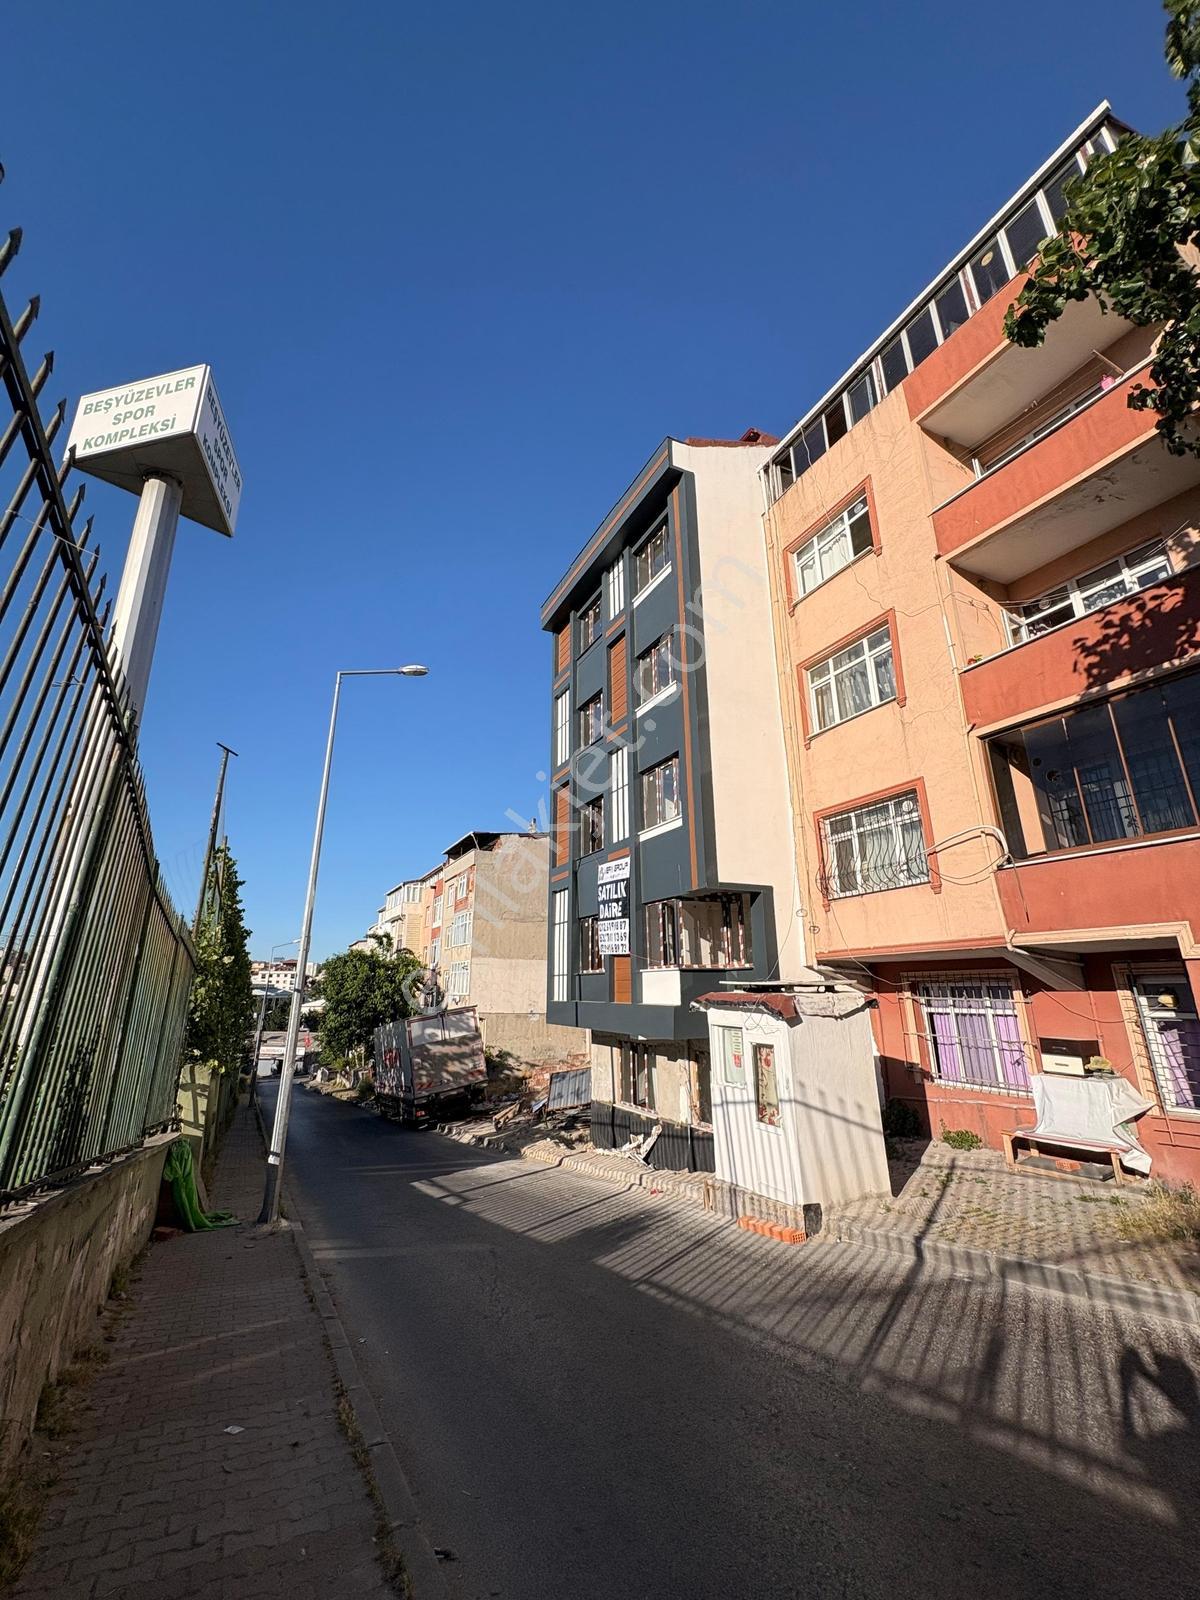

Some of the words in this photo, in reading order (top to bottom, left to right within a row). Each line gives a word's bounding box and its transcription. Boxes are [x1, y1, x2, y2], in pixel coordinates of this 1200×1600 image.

[83, 377, 196, 415] BEŞYÜZEVLER
[112, 404, 156, 426] SPOR
[82, 413, 177, 451] KOMPLEKSİ
[598, 881, 627, 901] SATILIK
